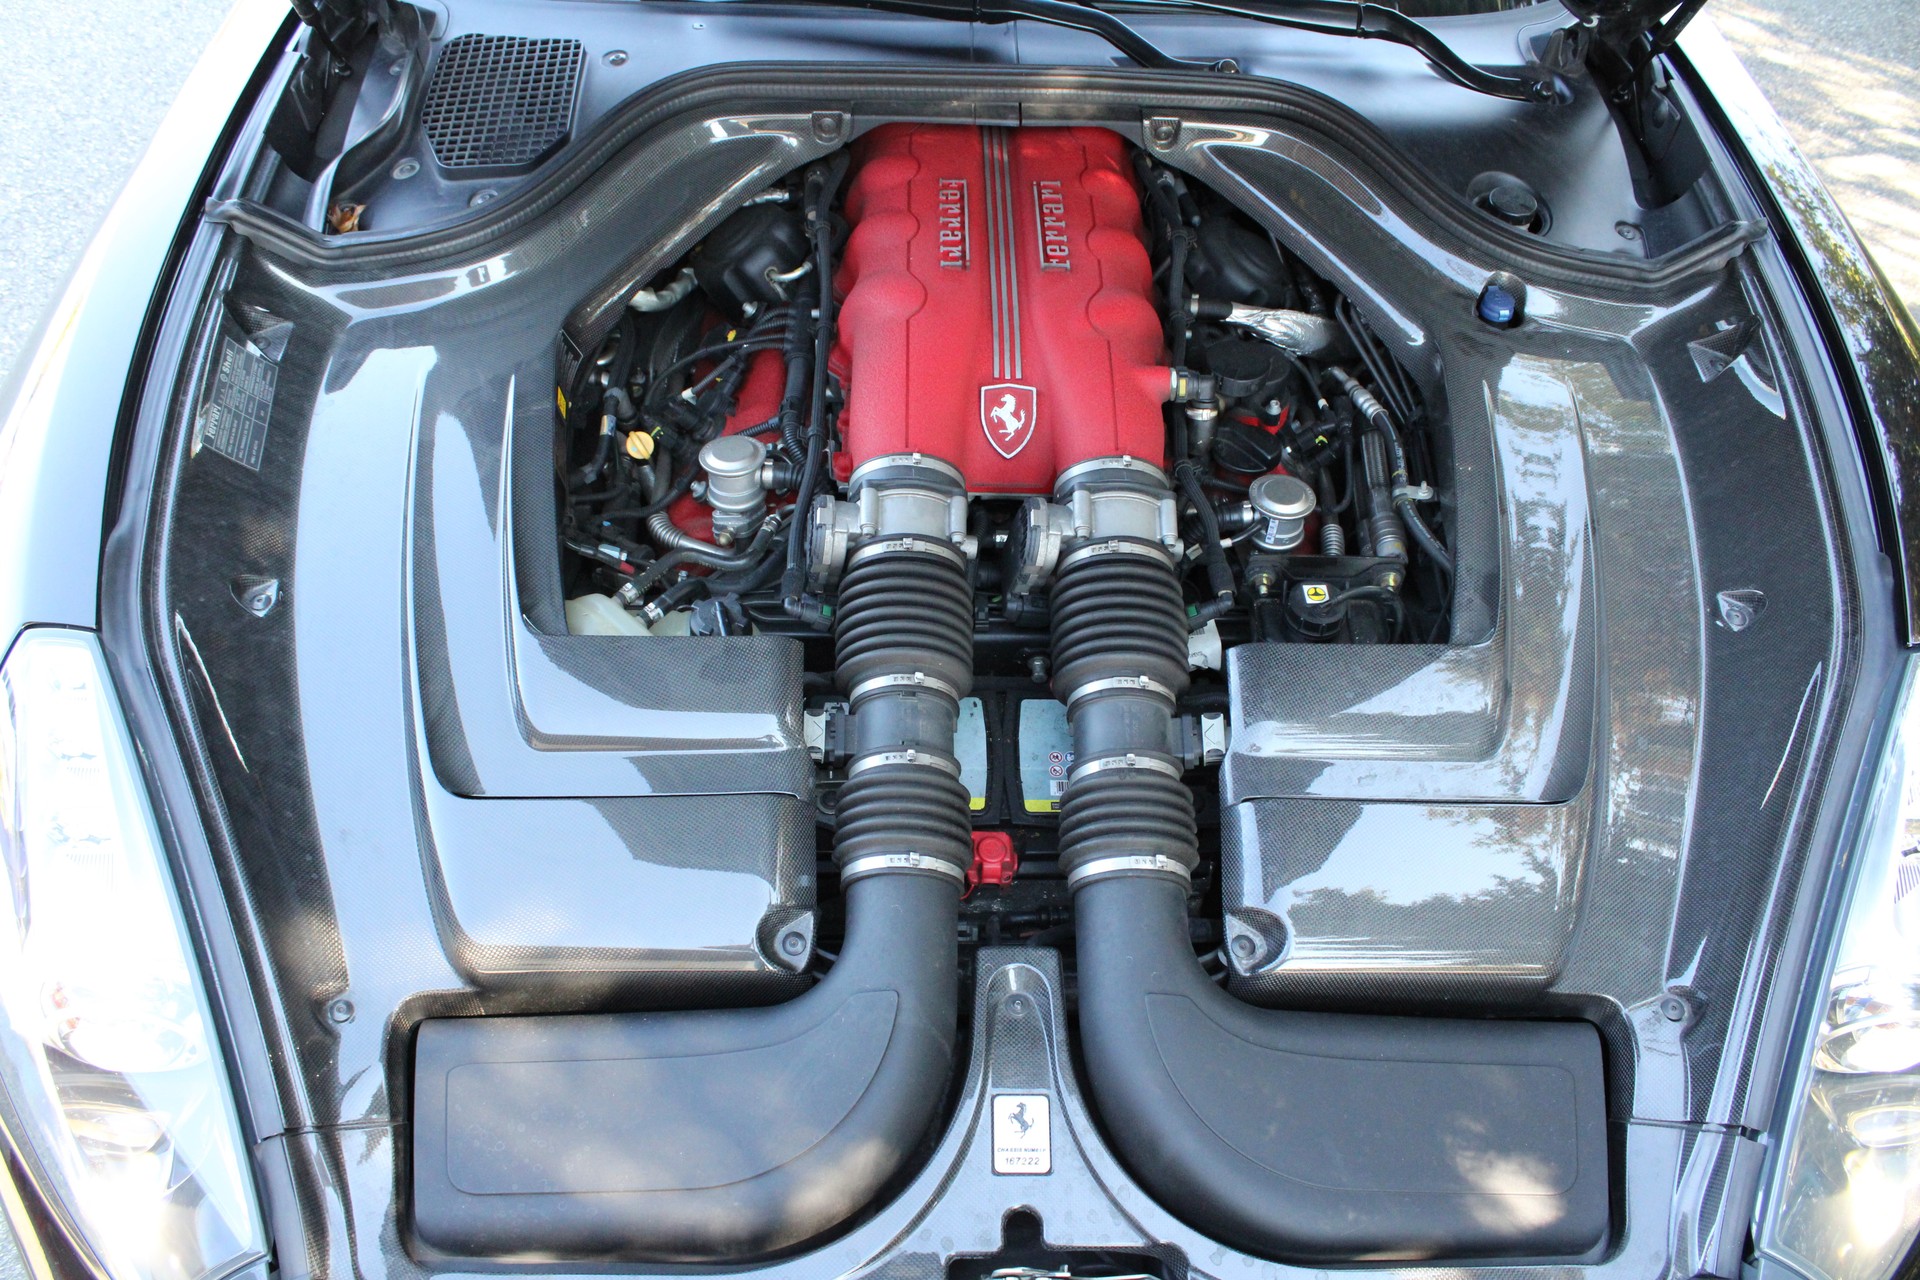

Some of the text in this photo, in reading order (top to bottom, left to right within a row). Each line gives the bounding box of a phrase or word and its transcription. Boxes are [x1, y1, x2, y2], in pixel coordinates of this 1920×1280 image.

[939, 178, 970, 268] Ferrari
[1033, 180, 1071, 270] Ferrari
[205, 404, 222, 439] Ferrari
[222, 349, 234, 374] Shell
